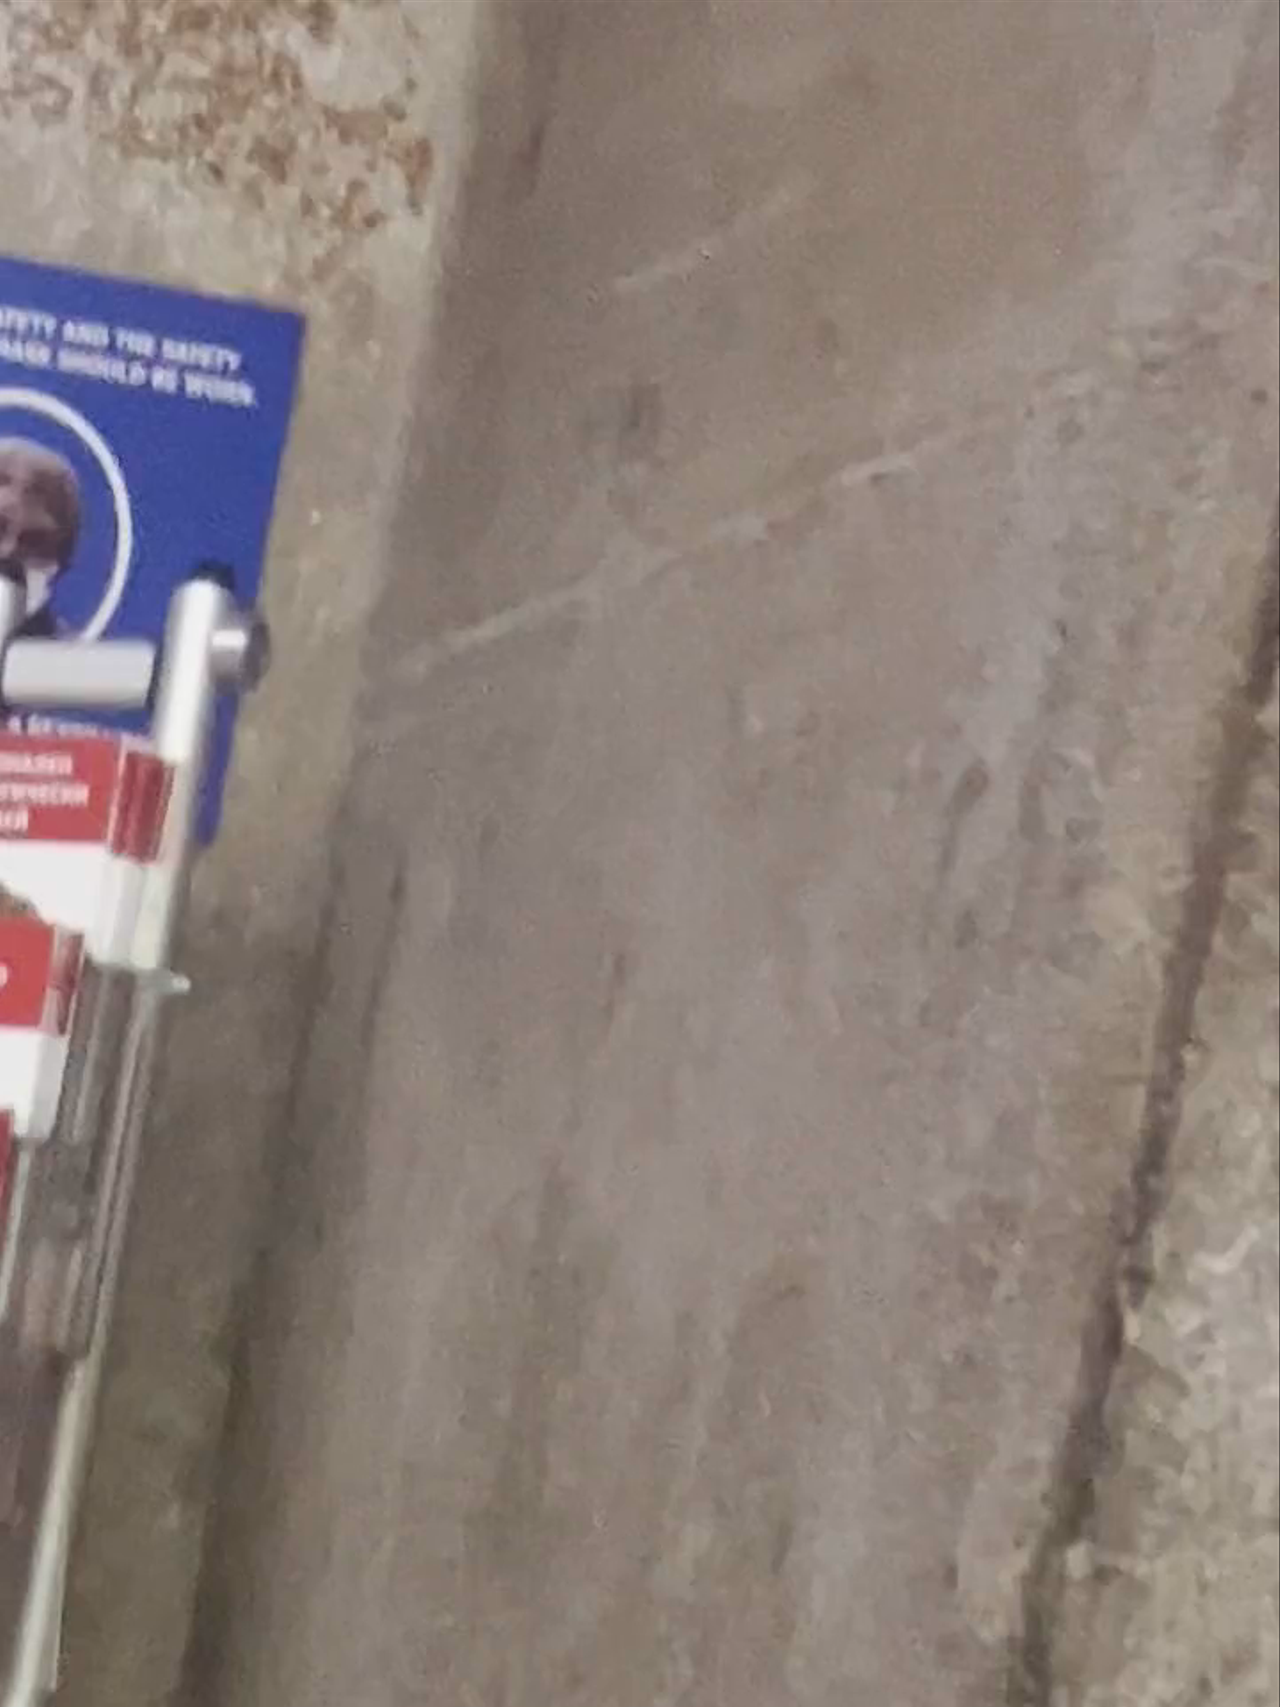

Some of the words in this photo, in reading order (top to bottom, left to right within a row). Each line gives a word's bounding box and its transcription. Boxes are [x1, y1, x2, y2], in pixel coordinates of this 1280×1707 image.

[62, 319, 109, 346] AND
[114, 327, 155, 356] THE
[161, 338, 240, 371] SAFETY
[57, 347, 146, 386] SHOULD
[151, 365, 177, 393] BE
